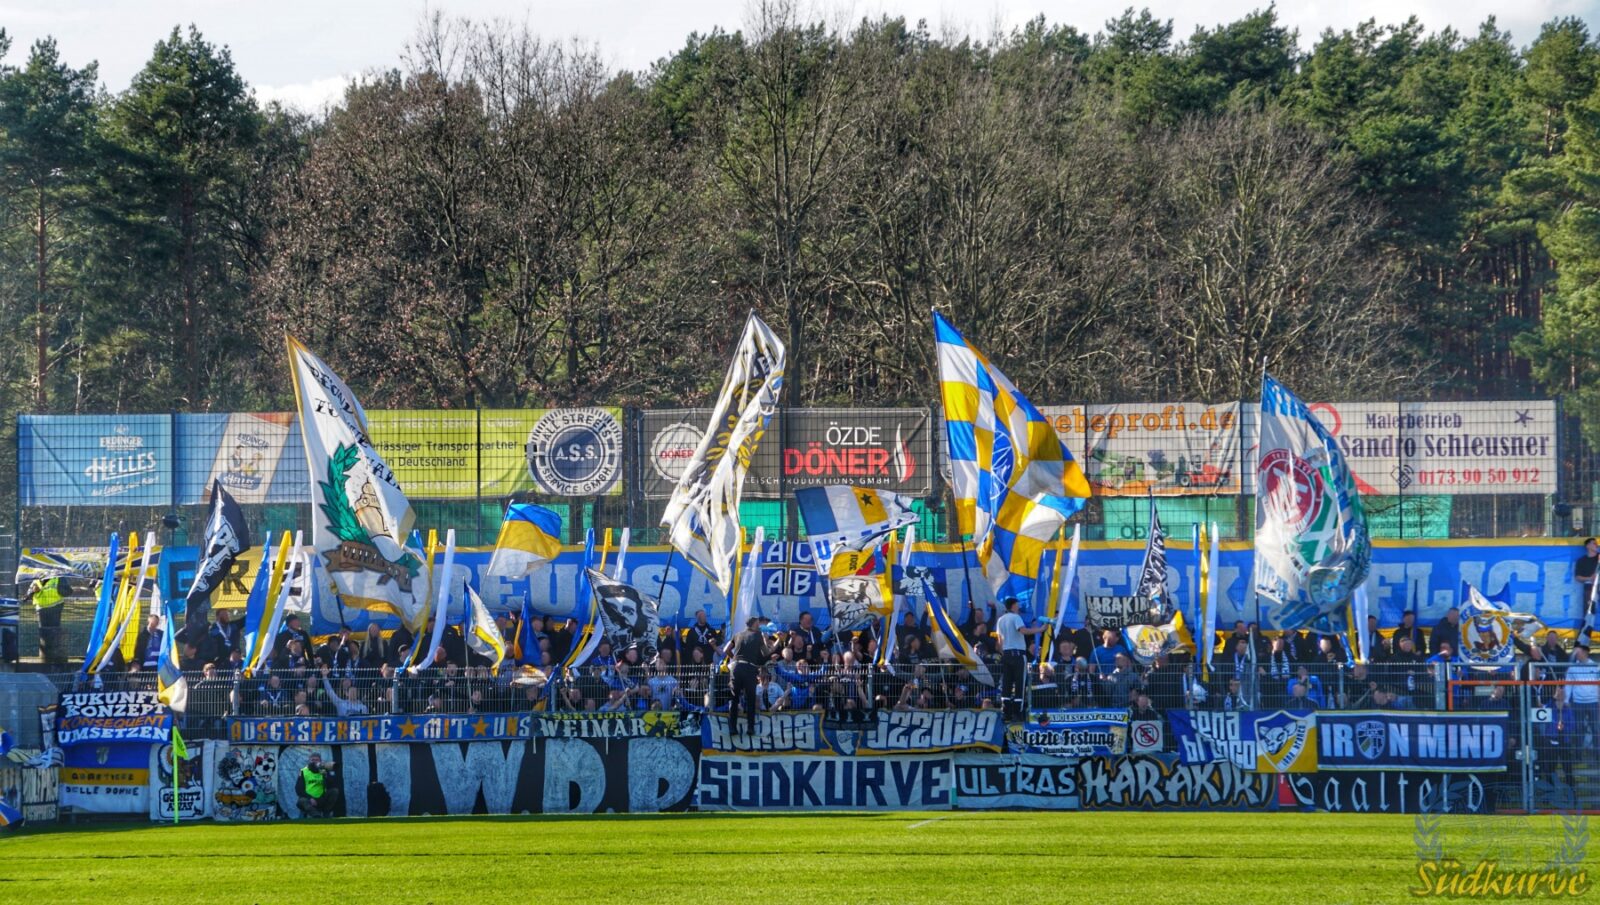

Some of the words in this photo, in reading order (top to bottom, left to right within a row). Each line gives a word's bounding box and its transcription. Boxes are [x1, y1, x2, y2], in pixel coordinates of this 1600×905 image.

[542, 420, 561, 441] ALL
[561, 413, 611, 438] STREETS
[1366, 413, 1462, 430] Malerbetrieb
[826, 421, 882, 446] ÖZDE
[372, 440, 421, 455] erlässiger
[427, 439, 518, 454] Transporpartner
[555, 443, 598, 462] A.S.S.
[1340, 433, 1416, 457] Sandro
[1424, 433, 1549, 457] Schleusner
[84, 451, 157, 483] HELLES
[399, 456, 468, 467] Deutschland.
[783, 442, 889, 475] DÖNER
[542, 468, 578, 494] SERVICE
[584, 466, 612, 492] GMBH
[1487, 467, 1507, 484] 50
[1513, 467, 1540, 484] 912
[61, 691, 159, 706] ZUKUNFT
[65, 703, 165, 718] KONZEPT
[553, 711, 625, 720] SEKTION
[1050, 713, 1098, 722] ADOLESCENT
[1100, 713, 1125, 722] CREW
[1536, 709, 1548, 720] C
[61, 715, 168, 729] KONSEQUENT
[231, 718, 392, 742] AUSGESPERRTE
[423, 717, 468, 739] MIT
[493, 716, 531, 738] UNS
[539, 717, 648, 738] WEIMAR
[58, 726, 170, 744] UMSETZEN
[1417, 723, 1504, 759] MIND
[701, 759, 951, 807] SÜDKURVE
[958, 763, 1078, 796] ULTRAS
[1081, 757, 1268, 805] HARAKIRI
